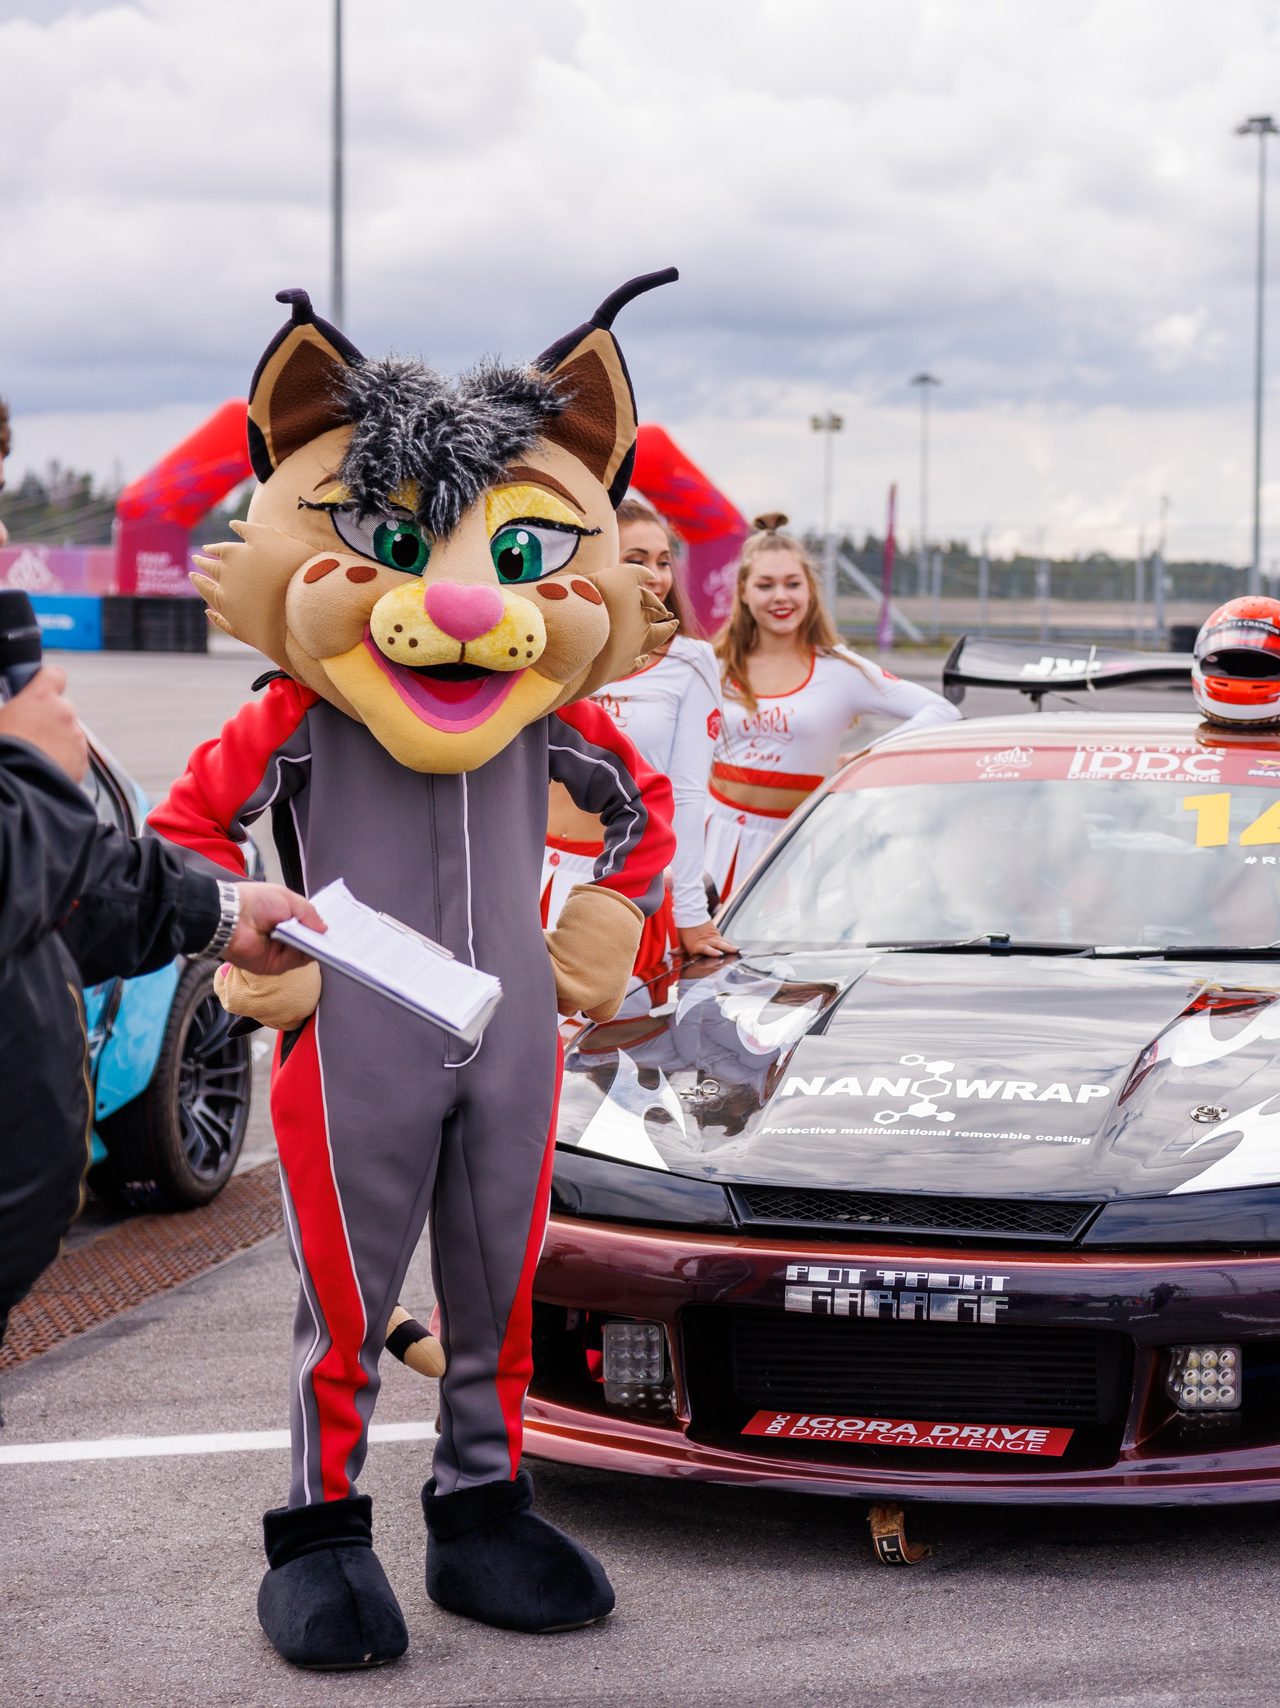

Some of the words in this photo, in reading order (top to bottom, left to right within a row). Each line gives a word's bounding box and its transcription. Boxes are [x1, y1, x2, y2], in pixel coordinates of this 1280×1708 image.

[1243, 620, 1280, 635] CHANDON
[1070, 751, 1224, 775] IDDC
[1067, 771, 1118, 780] DRIFT
[1120, 772, 1221, 783] CHALLENGE
[761, 1126, 837, 1136] Protective
[840, 1127, 951, 1137] multifunctional
[955, 1131, 1031, 1141] removable
[1036, 1134, 1091, 1145] coating
[785, 1285, 1009, 1323] GARAGE
[764, 1414, 791, 1434] IDDC
[796, 1416, 919, 1436] IGORA
[930, 1425, 1050, 1442] DRIVE
[788, 1427, 873, 1440] DRIFT
[877, 1434, 1043, 1452] CHALLENGE
